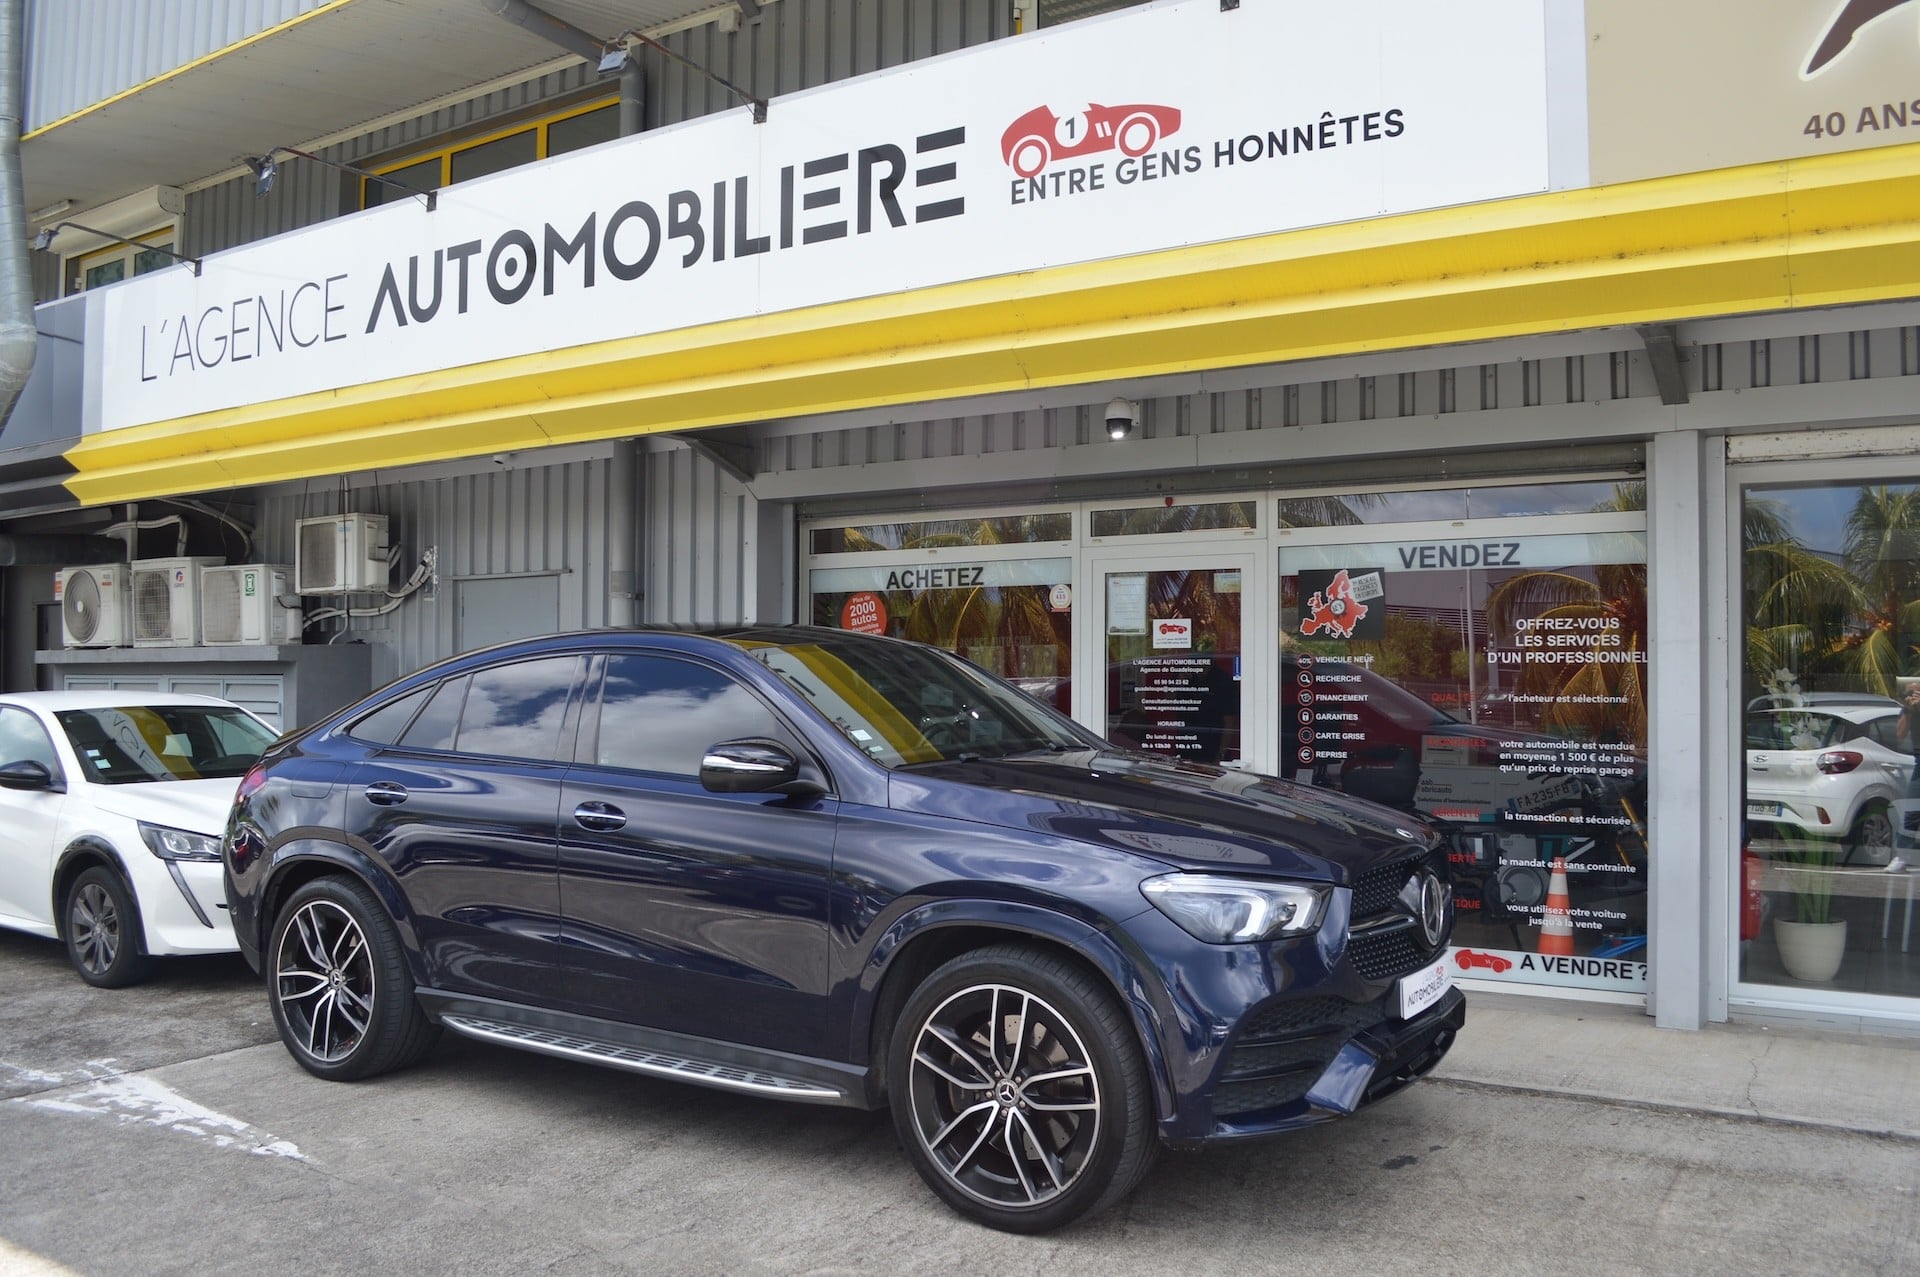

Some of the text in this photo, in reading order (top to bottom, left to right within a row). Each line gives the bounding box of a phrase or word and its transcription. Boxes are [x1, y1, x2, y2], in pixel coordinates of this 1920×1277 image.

[1803, 111, 1846, 139] 40
[1010, 108, 1404, 205] ENTRE GENS HONNÊTES
[141, 126, 966, 382] L'AGENCE AUTOMOBILIERE
[1398, 543, 1521, 569] VENDEZ
[886, 567, 984, 589] ACHETEZ
[849, 600, 876, 617] 2000
[851, 613, 878, 626] autos
[1516, 617, 1620, 630] OFFREZ-VOUS
[1515, 634, 1621, 647] LES SERVICES
[1487, 651, 1648, 664] D'UN PROFESSIONNEL
[1508, 693, 1628, 704] l'acheteur est sélectionné
[1500, 740, 1635, 751] votre automobile est vendue
[1500, 752, 1634, 765] en moyenne 1 500 € de plus
[1499, 763, 1634, 777] qu'un prix de reprise garage
[1504, 811, 1632, 826] la transaction est sécurisée
[1498, 856, 1636, 873] le mandat est sans contrainte
[1506, 904, 1627, 919] vous utilisez votre voiture
[1564, 918, 1574, 927] la
[1575, 920, 1603, 930] vente
[1520, 954, 1535, 970] A
